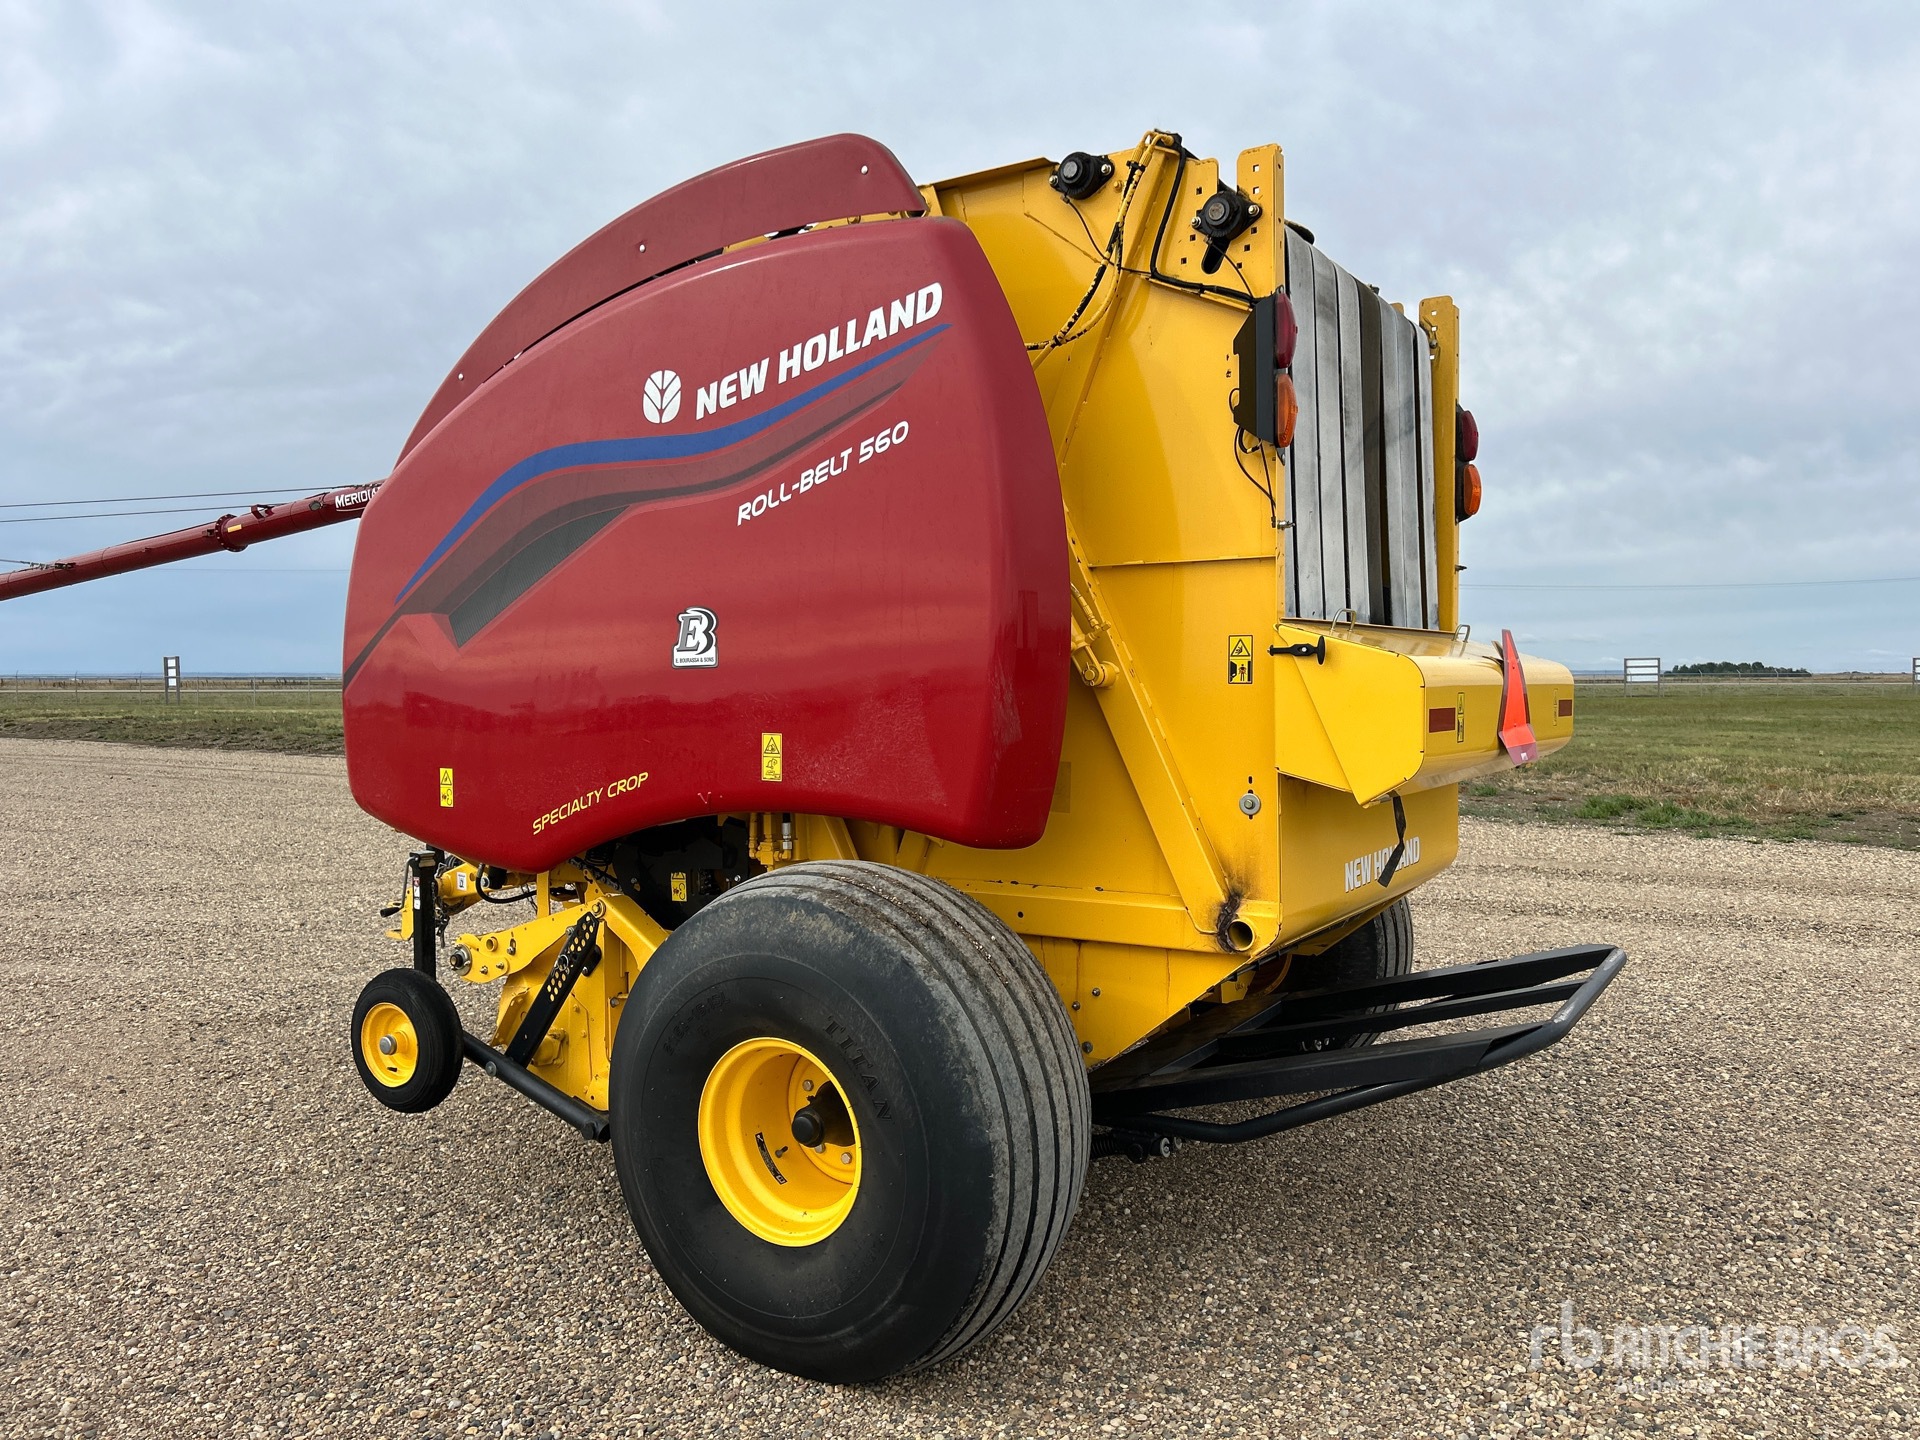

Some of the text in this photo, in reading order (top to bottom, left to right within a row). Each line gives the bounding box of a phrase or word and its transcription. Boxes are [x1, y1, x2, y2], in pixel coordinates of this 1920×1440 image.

[696, 282, 943, 421] NEW HOLLAND
[737, 420, 909, 526] ROLL-BELT 560
[532, 771, 649, 835] SPECIALTY CROP
[1345, 837, 1420, 893] NEW HOAND
[822, 1014, 892, 1123] TITAN
